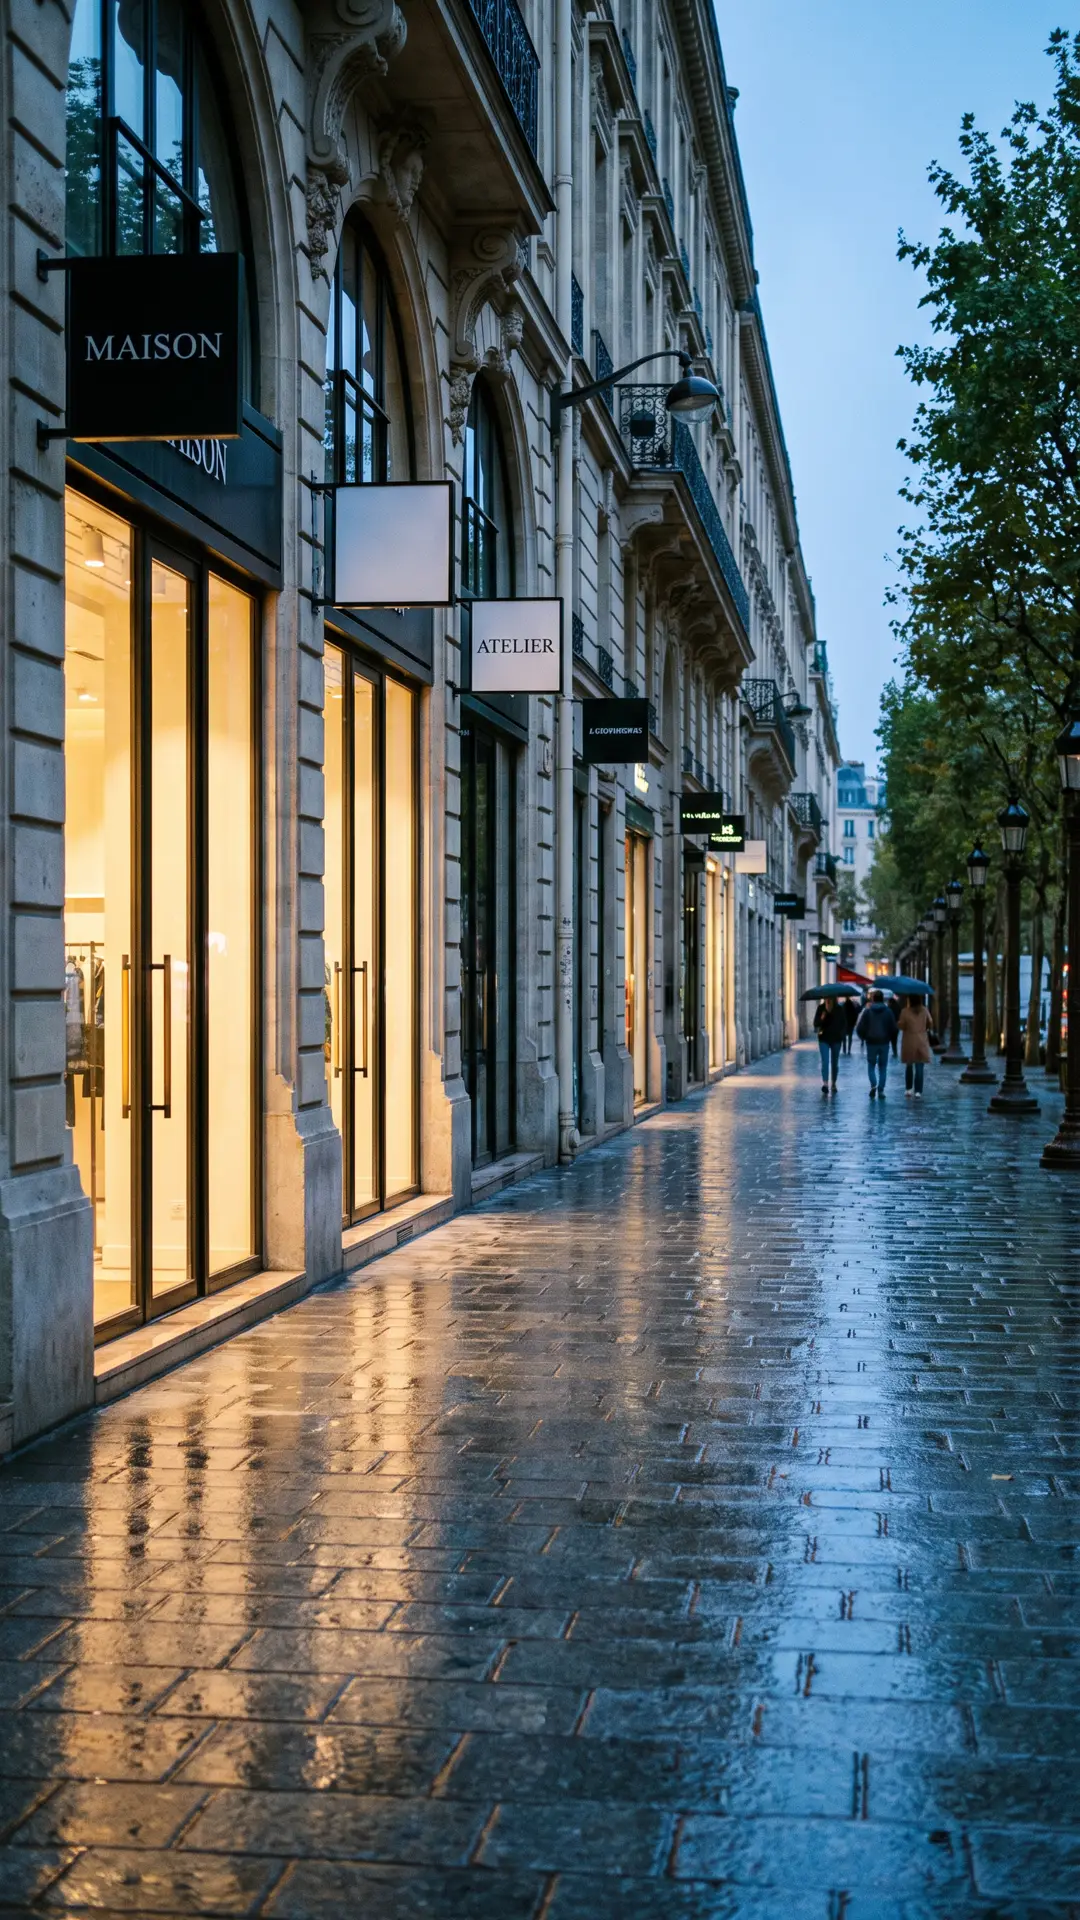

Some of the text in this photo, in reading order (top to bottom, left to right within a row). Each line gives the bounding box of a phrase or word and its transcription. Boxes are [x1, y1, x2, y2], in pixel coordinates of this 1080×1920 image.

[84, 332, 224, 361] MAISON
[166, 439, 228, 486] SON
[476, 638, 555, 654] ATELIER
